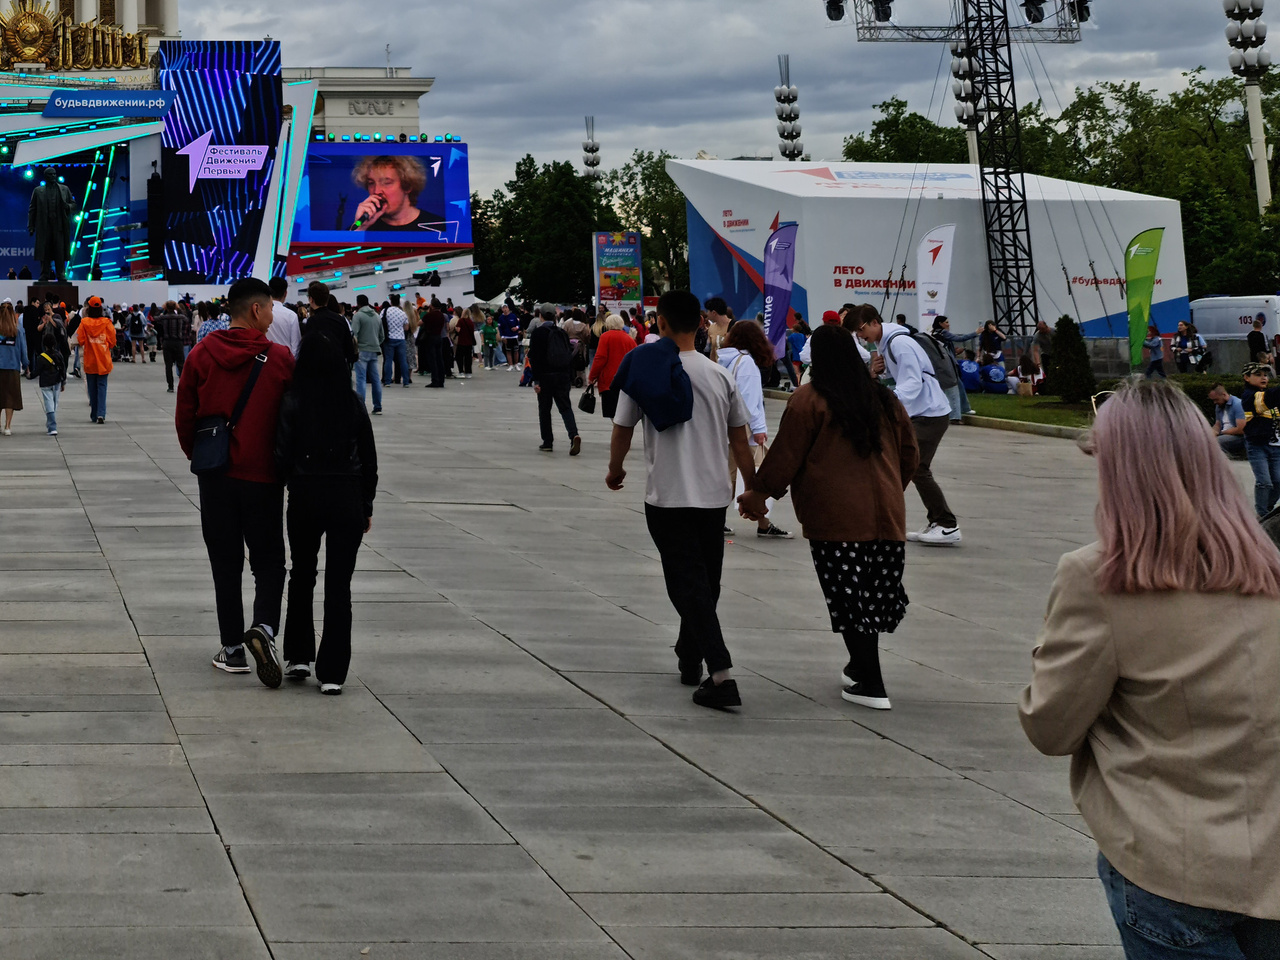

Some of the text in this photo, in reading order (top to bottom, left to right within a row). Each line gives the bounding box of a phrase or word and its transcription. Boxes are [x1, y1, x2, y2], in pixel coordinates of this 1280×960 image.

[55, 97, 166, 109] будьвдвижении.рф
[210, 147, 263, 156] Фестиваль
[206, 156, 257, 165] Движения
[203, 167, 241, 176] Первых
[833, 266, 864, 275] ЛЕТО
[834, 279, 916, 289] В ДВИЖЕНИИ
[1238, 315, 1253, 325] 103
